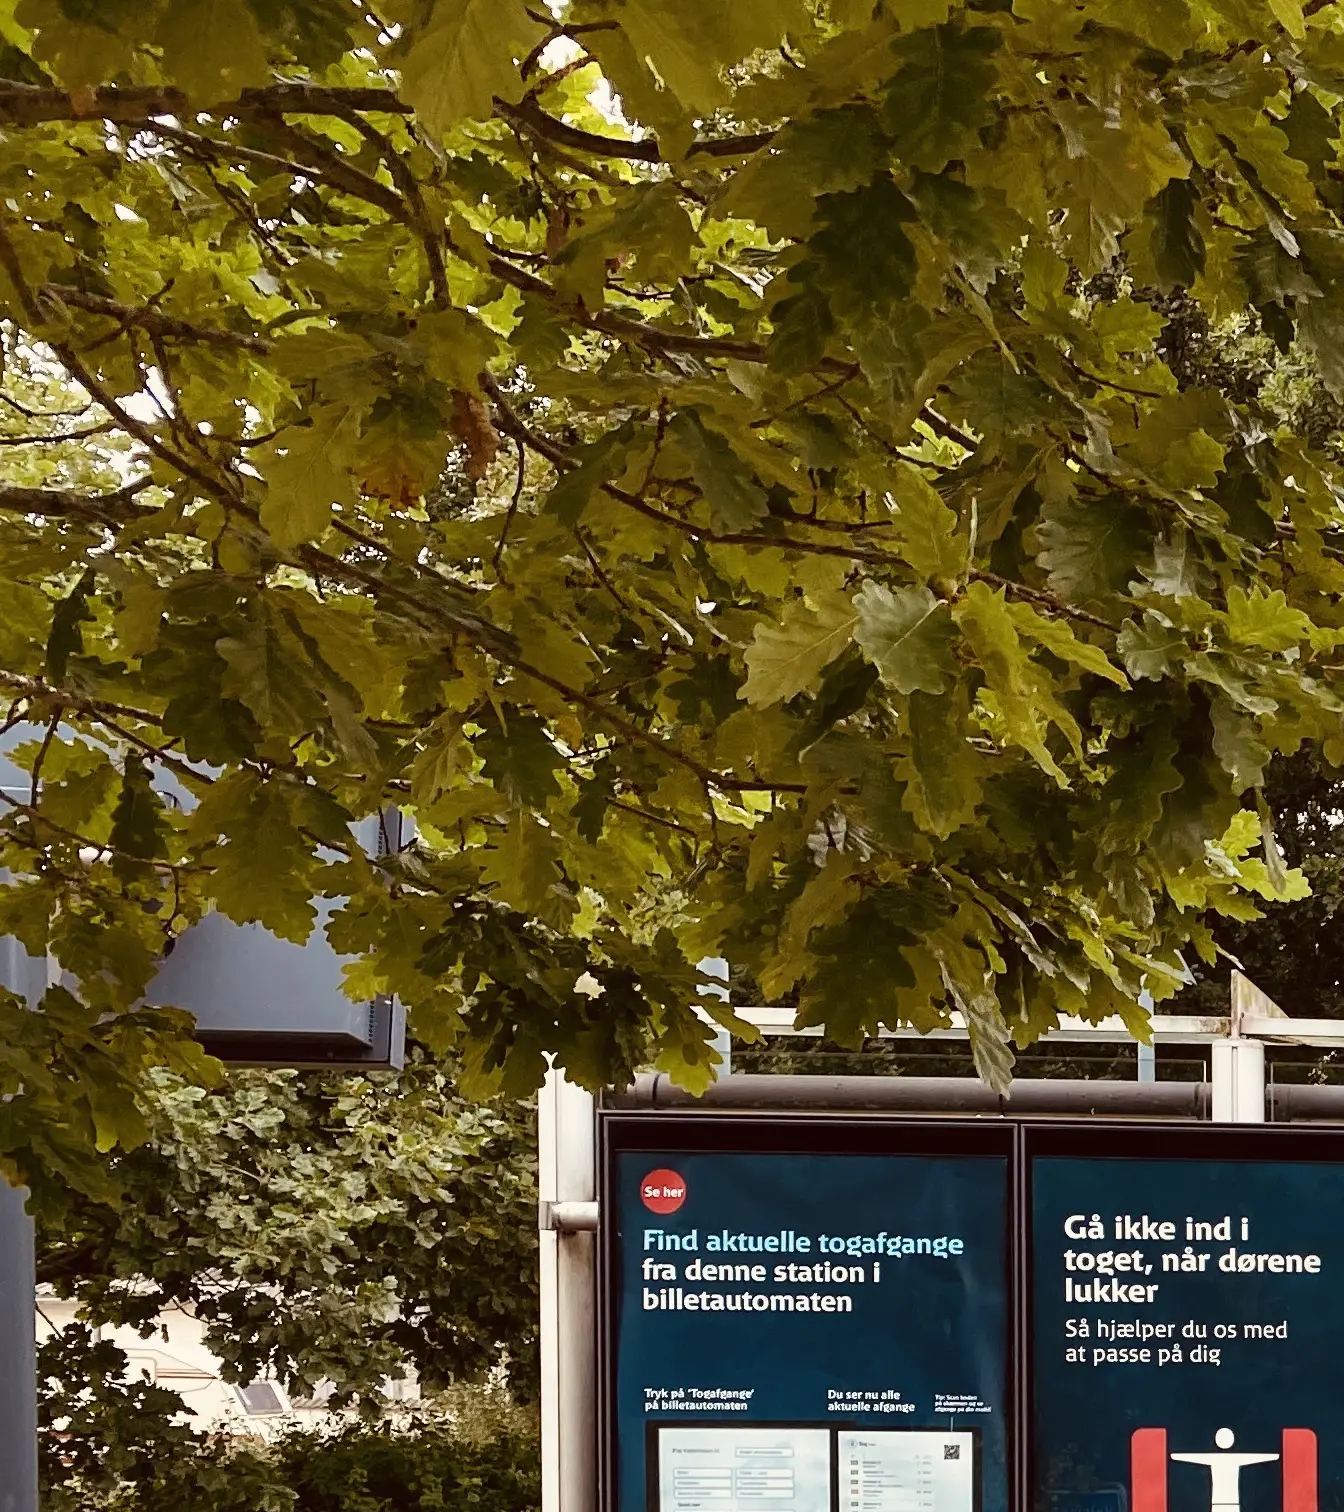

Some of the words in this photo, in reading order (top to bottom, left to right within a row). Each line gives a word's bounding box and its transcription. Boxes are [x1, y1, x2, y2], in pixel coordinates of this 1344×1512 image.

[643, 1186, 661, 1198] Se
[663, 1186, 684, 1198] her
[1064, 1214, 1105, 1240] Gå
[1115, 1215, 1176, 1241] ikke
[1185, 1216, 1232, 1241] ind
[1241, 1217, 1249, 1241] i
[643, 1229, 698, 1252] Find
[706, 1230, 811, 1253] aktuelle
[818, 1232, 964, 1258] togafgange
[642, 1258, 677, 1281] fra
[685, 1259, 767, 1282] denne
[773, 1262, 865, 1283] station
[873, 1262, 881, 1283] i
[1064, 1249, 1153, 1276] toget,
[1162, 1246, 1211, 1272] når
[1218, 1247, 1322, 1273] dørene
[642, 1288, 853, 1312] billetautomaten
[1064, 1277, 1159, 1303] lukker
[1065, 1318, 1090, 1338] Så
[1097, 1319, 1176, 1342] hjælper
[1181, 1320, 1207, 1339] du
[1213, 1324, 1237, 1339] os
[1243, 1320, 1288, 1339] med
[1065, 1345, 1086, 1363] at
[1093, 1347, 1151, 1366] passe
[1158, 1343, 1183, 1366] på
[1189, 1345, 1221, 1366] dig
[644, 1388, 668, 1400] Tryk
[670, 1388, 685, 1400] på
[644, 1400, 659, 1412] på
[662, 1400, 748, 1410] billetautomaten
[827, 1389, 843, 1400] Du
[846, 1391, 863, 1400] ser
[865, 1391, 879, 1400] nu
[881, 1390, 901, 1400] alle
[827, 1402, 871, 1412] aktuelle
[873, 1402, 916, 1413] afgange
